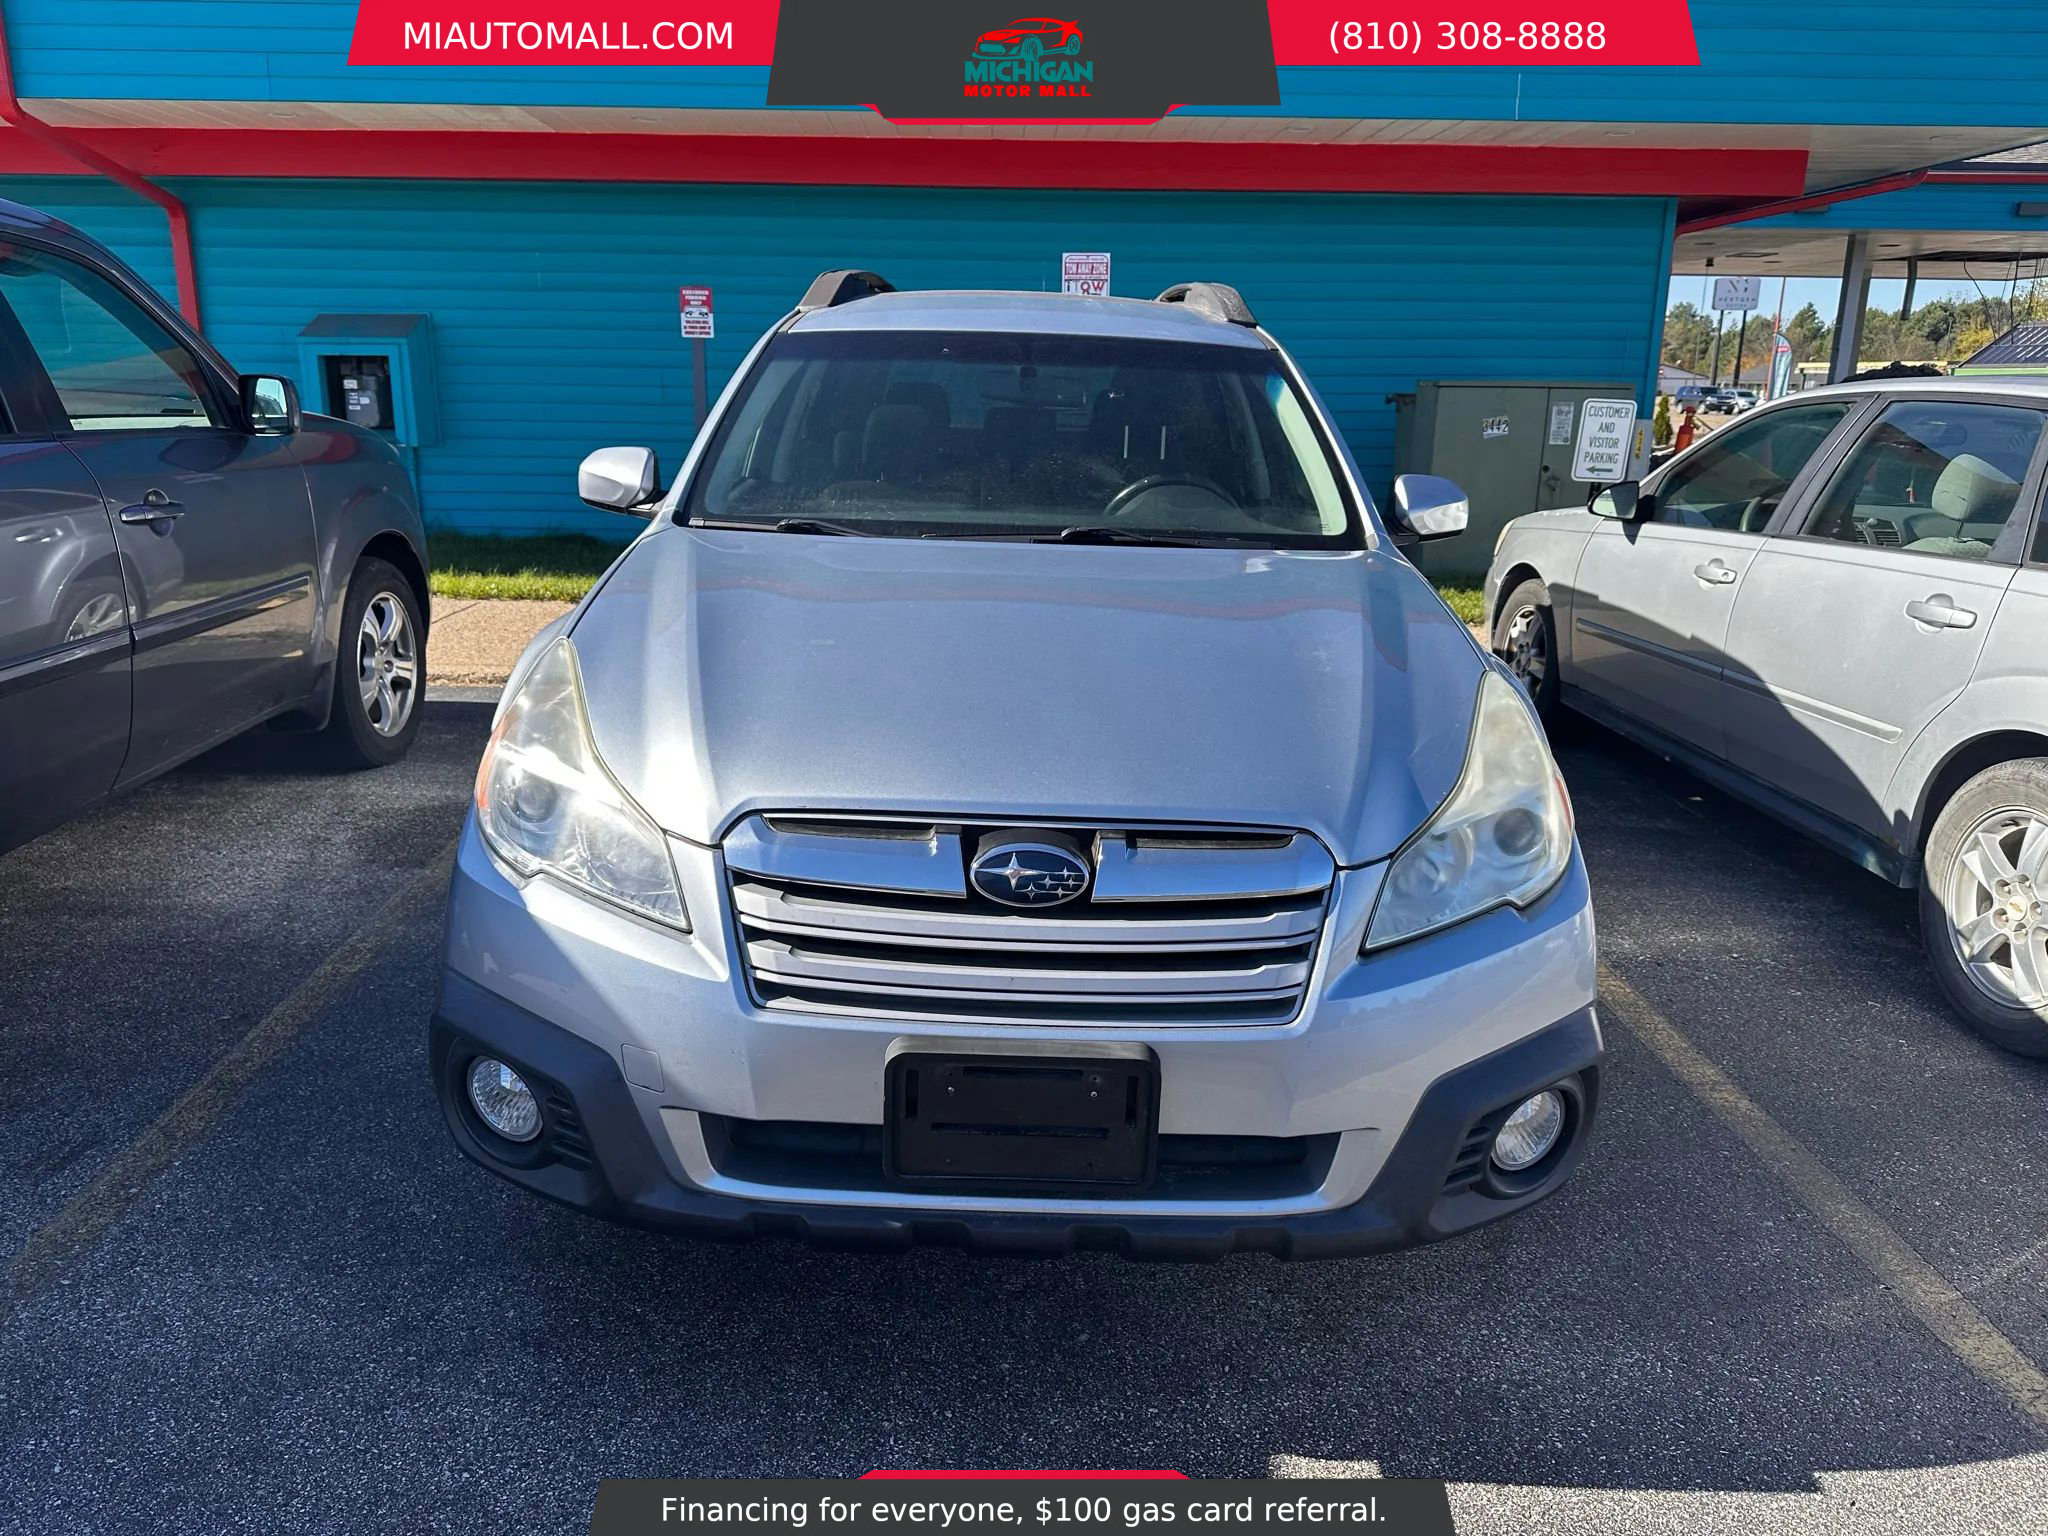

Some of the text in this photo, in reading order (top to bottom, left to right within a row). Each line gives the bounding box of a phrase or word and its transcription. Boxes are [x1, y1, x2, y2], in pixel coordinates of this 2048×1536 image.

[1588, 405, 1631, 419] CUSTOMER
[1597, 421, 1616, 434] AND
[1589, 436, 1620, 449] VISITOR
[1583, 451, 1620, 464] PARKING
